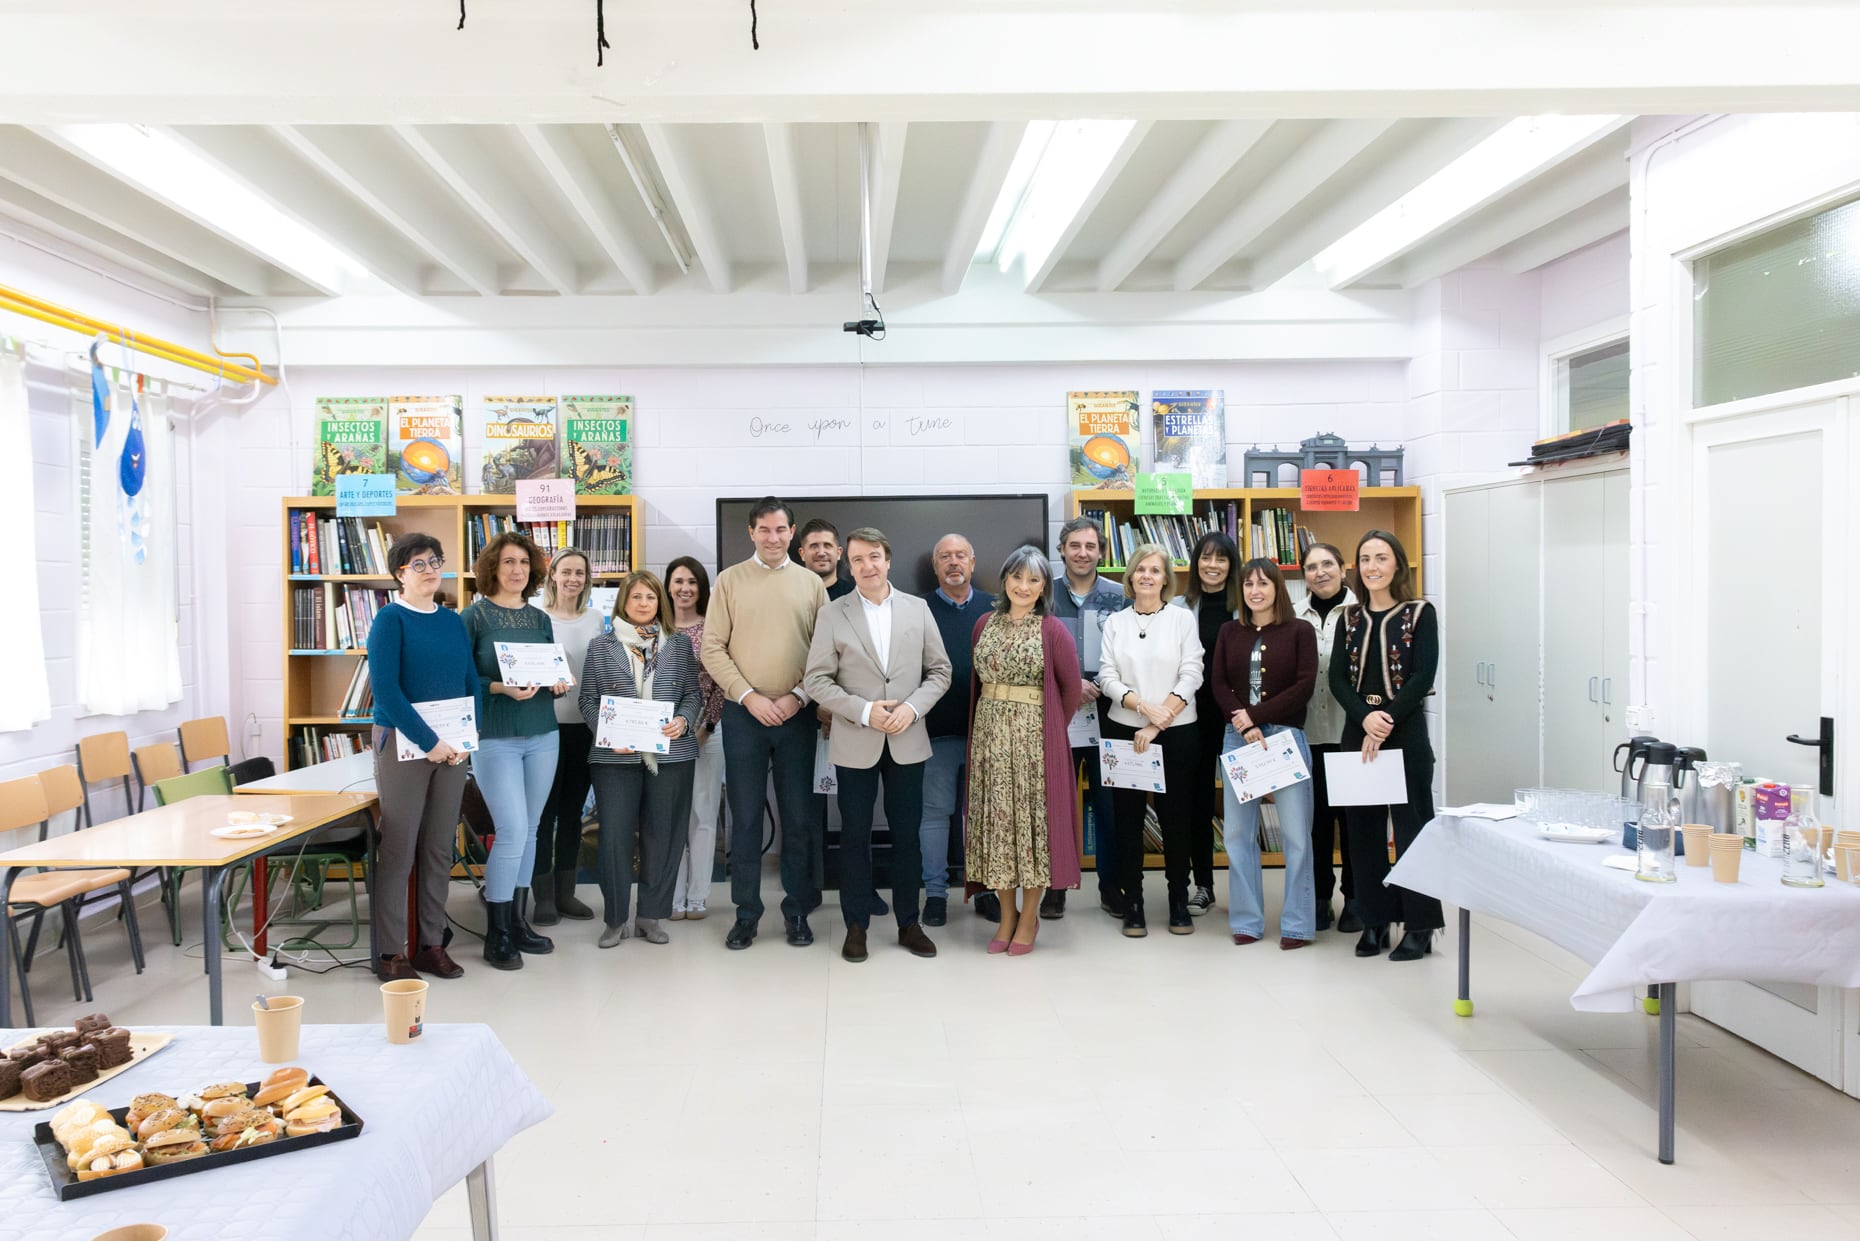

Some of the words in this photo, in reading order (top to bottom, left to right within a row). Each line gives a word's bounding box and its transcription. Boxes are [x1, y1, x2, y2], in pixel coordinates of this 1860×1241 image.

[400, 419, 410, 428] EL
[412, 418, 450, 428] PLANETA
[1080, 414, 1089, 424] EL
[1091, 414, 1129, 424] PLANETA
[1165, 415, 1214, 425] ESTRELLAS
[328, 422, 375, 432] INSECTOS
[486, 424, 553, 438] DINOSAURIOS
[573, 421, 621, 431] INSECTOS
[750, 416, 791, 437] Once
[808, 418, 850, 440] upon
[873, 419, 886, 430] a
[1089, 424, 1120, 433] TIERRA
[1172, 425, 1214, 435] PLANETAS
[334, 431, 375, 443] ARAÑAS
[409, 427, 441, 438] TIERRA
[581, 430, 621, 442] ARAÑAS
[363, 478, 368, 487] 7
[1161, 477, 1167, 486] 5
[1328, 474, 1333, 483] 6
[540, 484, 550, 493] 91
[340, 490, 354, 499] ARTE
[356, 491, 360, 499] Y
[361, 490, 393, 499] DEPORTES
[528, 494, 564, 504] GEOGRAFÍA
